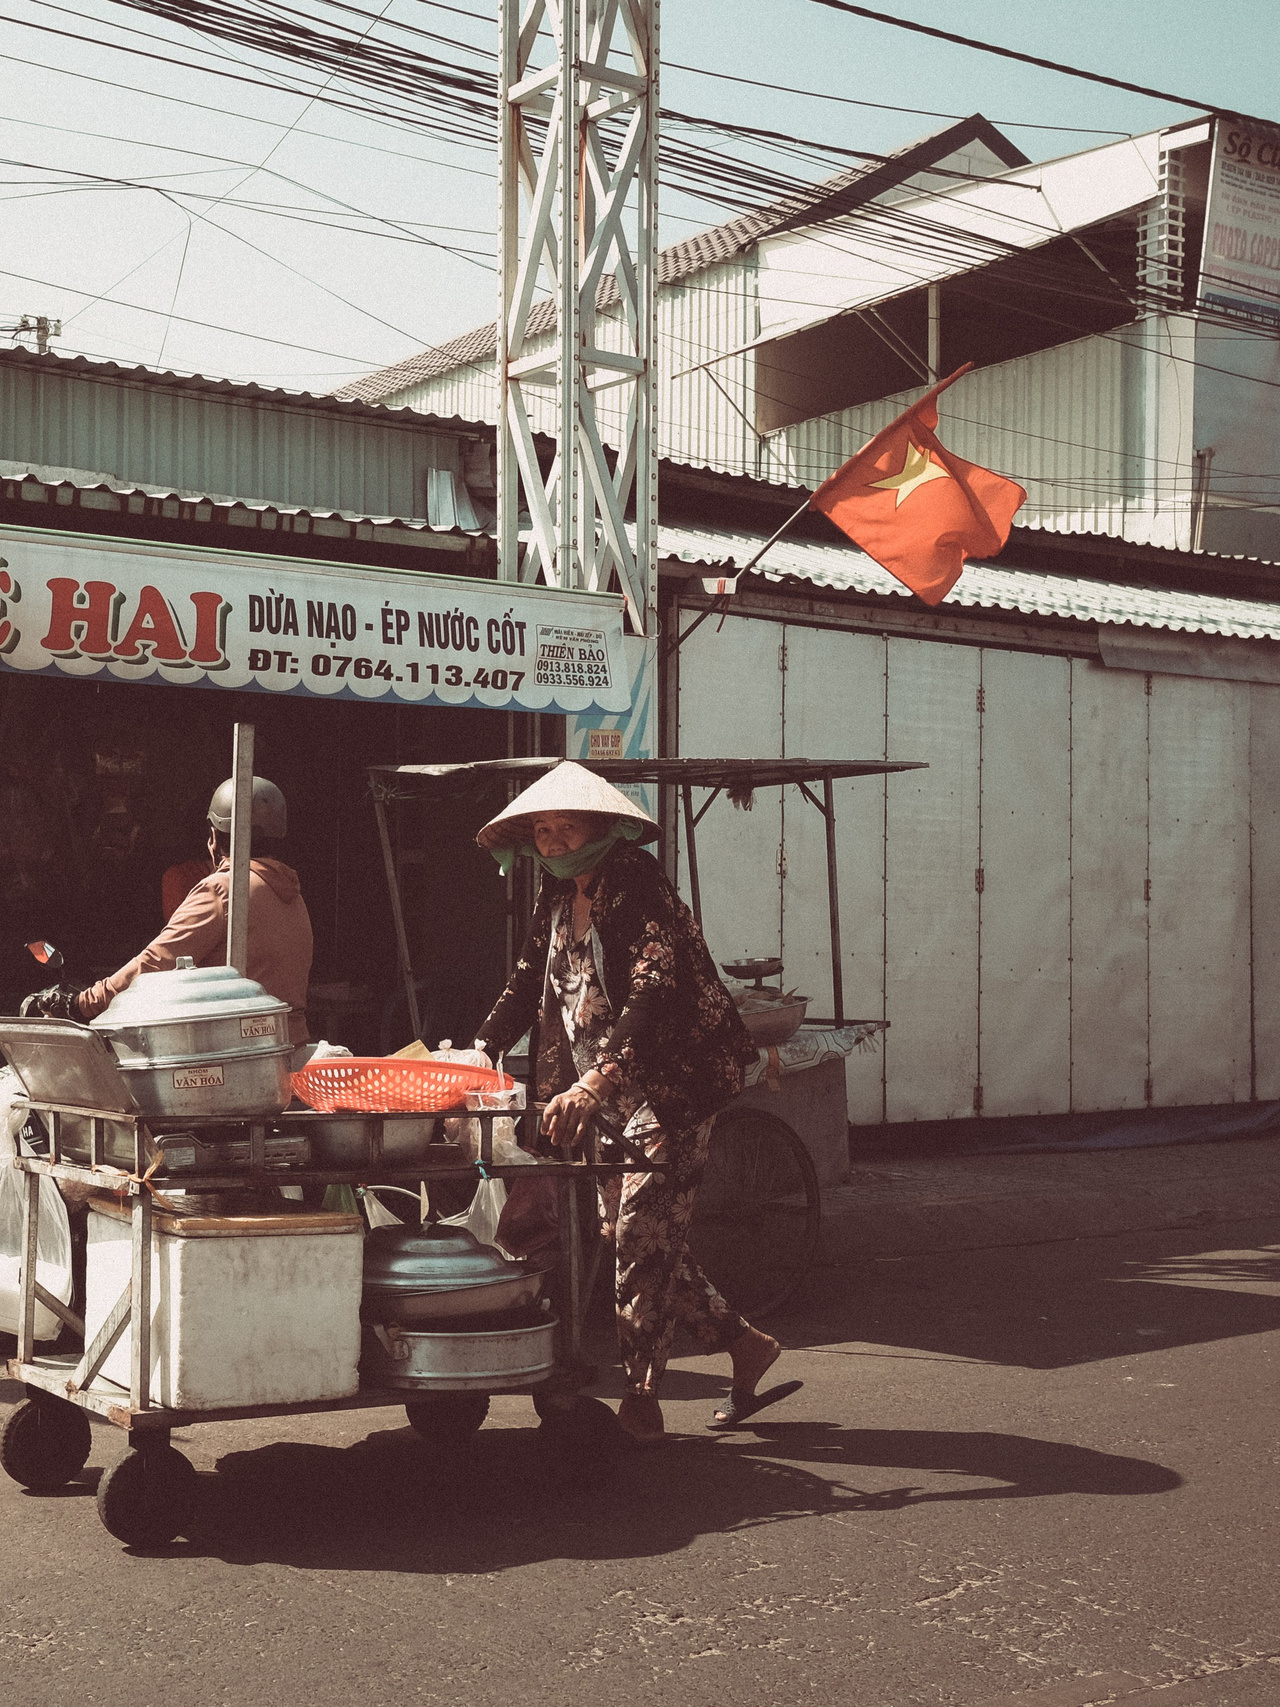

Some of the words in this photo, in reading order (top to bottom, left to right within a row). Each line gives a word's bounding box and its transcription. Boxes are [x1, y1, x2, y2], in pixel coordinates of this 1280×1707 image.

[1212, 222, 1248, 260] PHOTO
[40, 577, 231, 671] HAI
[248, 587, 299, 635] DỪA
[306, 600, 357, 648] NẠO
[381, 601, 410, 646] ÉP
[418, 606, 479, 652] NƯỚC
[487, 608, 527, 656] CỐT
[540, 643, 575, 660] THIÊN
[578, 644, 605, 662] BẢO
[248, 648, 299, 674] ĐT:
[310, 653, 526, 692] 0764.113.407
[537, 660, 608, 675] 0913.818.824
[536, 672, 609, 687] 0933.556.924
[243, 1026, 261, 1036] VĂN
[262, 1024, 275, 1035] HÓA
[176, 1075, 198, 1087] VĂN
[200, 1074, 222, 1086] HÓA
